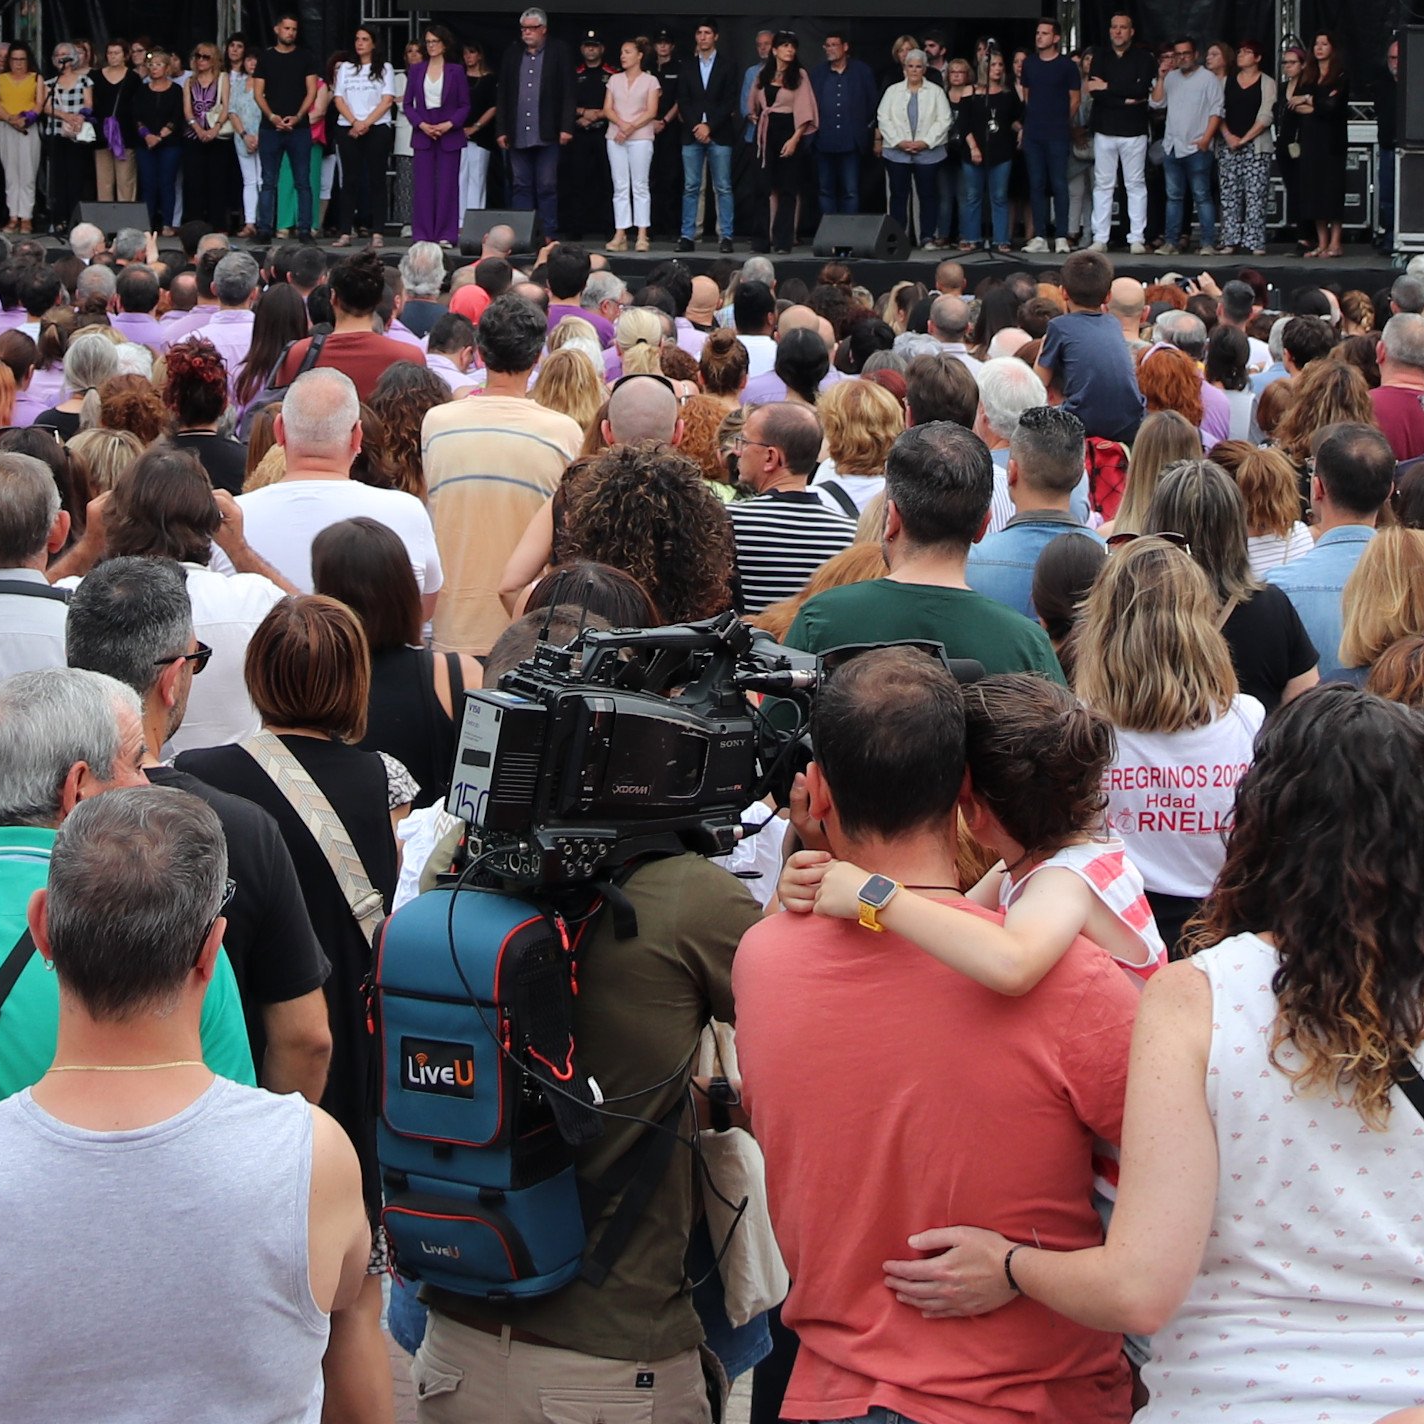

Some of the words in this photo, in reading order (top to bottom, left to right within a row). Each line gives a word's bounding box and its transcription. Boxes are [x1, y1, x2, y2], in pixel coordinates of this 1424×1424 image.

[719, 739, 746, 748] SONY
[1146, 792, 1195, 809] Hdad
[407, 1052, 475, 1087] LiveU
